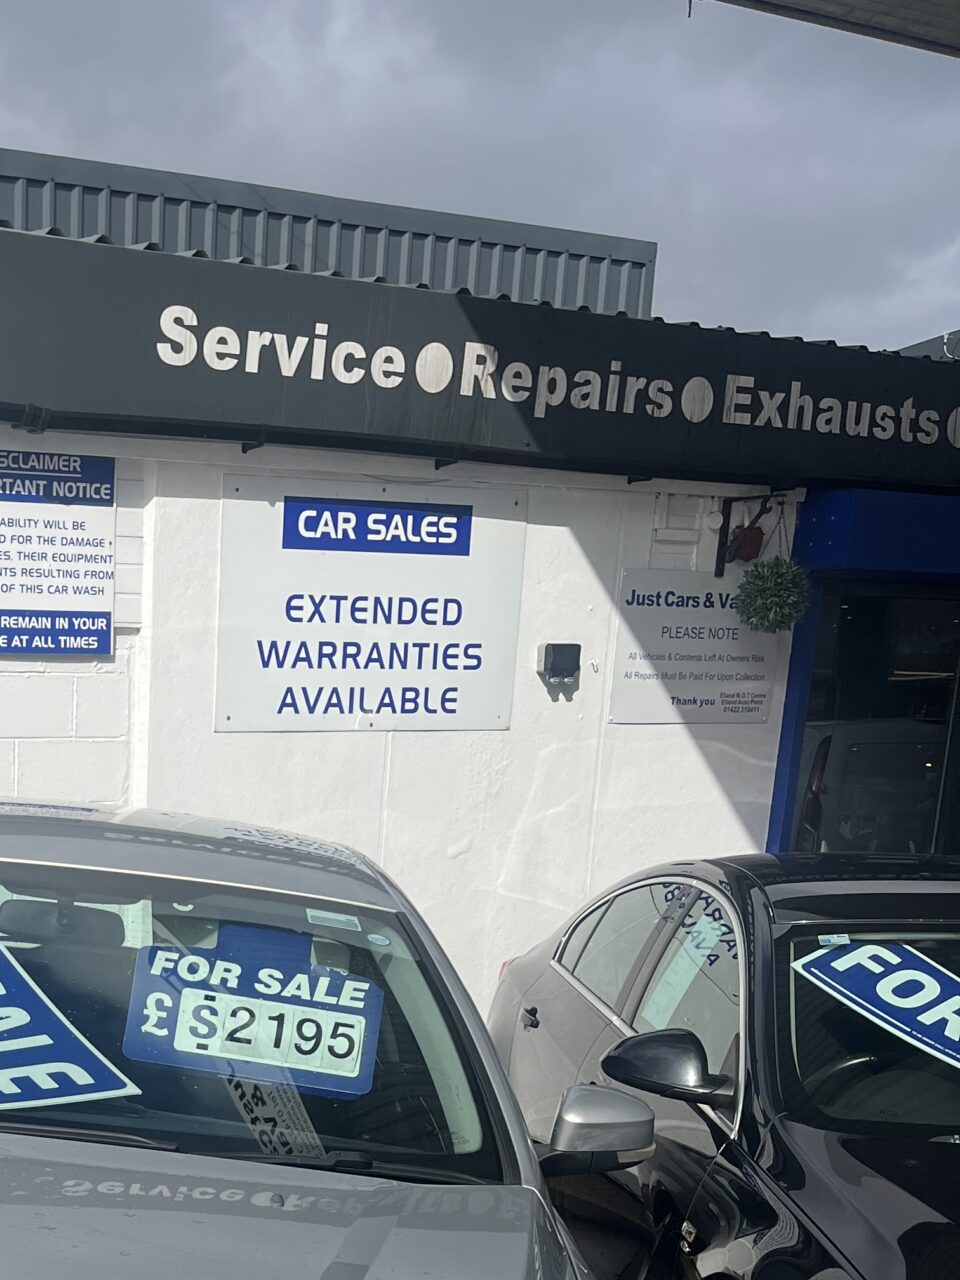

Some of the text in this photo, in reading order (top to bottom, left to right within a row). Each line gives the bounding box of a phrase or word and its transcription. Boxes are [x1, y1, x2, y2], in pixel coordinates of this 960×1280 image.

[156, 305, 405, 389] Service
[459, 341, 673, 418] Repairs
[722, 374, 939, 445] Exhausts
[52, 482, 111, 499] NOTICE
[43, 520, 68, 530] WILL
[72, 521, 86, 530] BE
[298, 510, 457, 543] CAR SALES
[10, 535, 32, 544] FOR
[36, 536, 56, 545] THE
[60, 537, 105, 547] DAMAGE
[17, 552, 47, 562] THEIR
[52, 553, 113, 564] EQUIPMENT
[21, 568, 79, 579] RESULTING
[84, 570, 113, 580] FROM
[0, 583, 15, 593] OF
[19, 584, 43, 594] THIS
[47, 585, 68, 595] CAR
[72, 586, 104, 596] WASH
[625, 589, 738, 609] Just Cars & Va
[285, 594, 462, 625] EXTENDED
[0, 615, 51, 629] REMAIN
[55, 617, 68, 629] IN
[72, 617, 107, 630] YOUR
[11, 635, 29, 647] AT
[32, 636, 54, 648] ALL
[58, 636, 97, 648] TIMES
[661, 626, 739, 640] PLEASE NOTE
[257, 640, 482, 670] WARRANTIES
[277, 686, 458, 714] AVAILABLE
[670, 696, 715, 708] Thank you
[150, 950, 370, 1008] FOR SALE
[141, 992, 172, 1036] £
